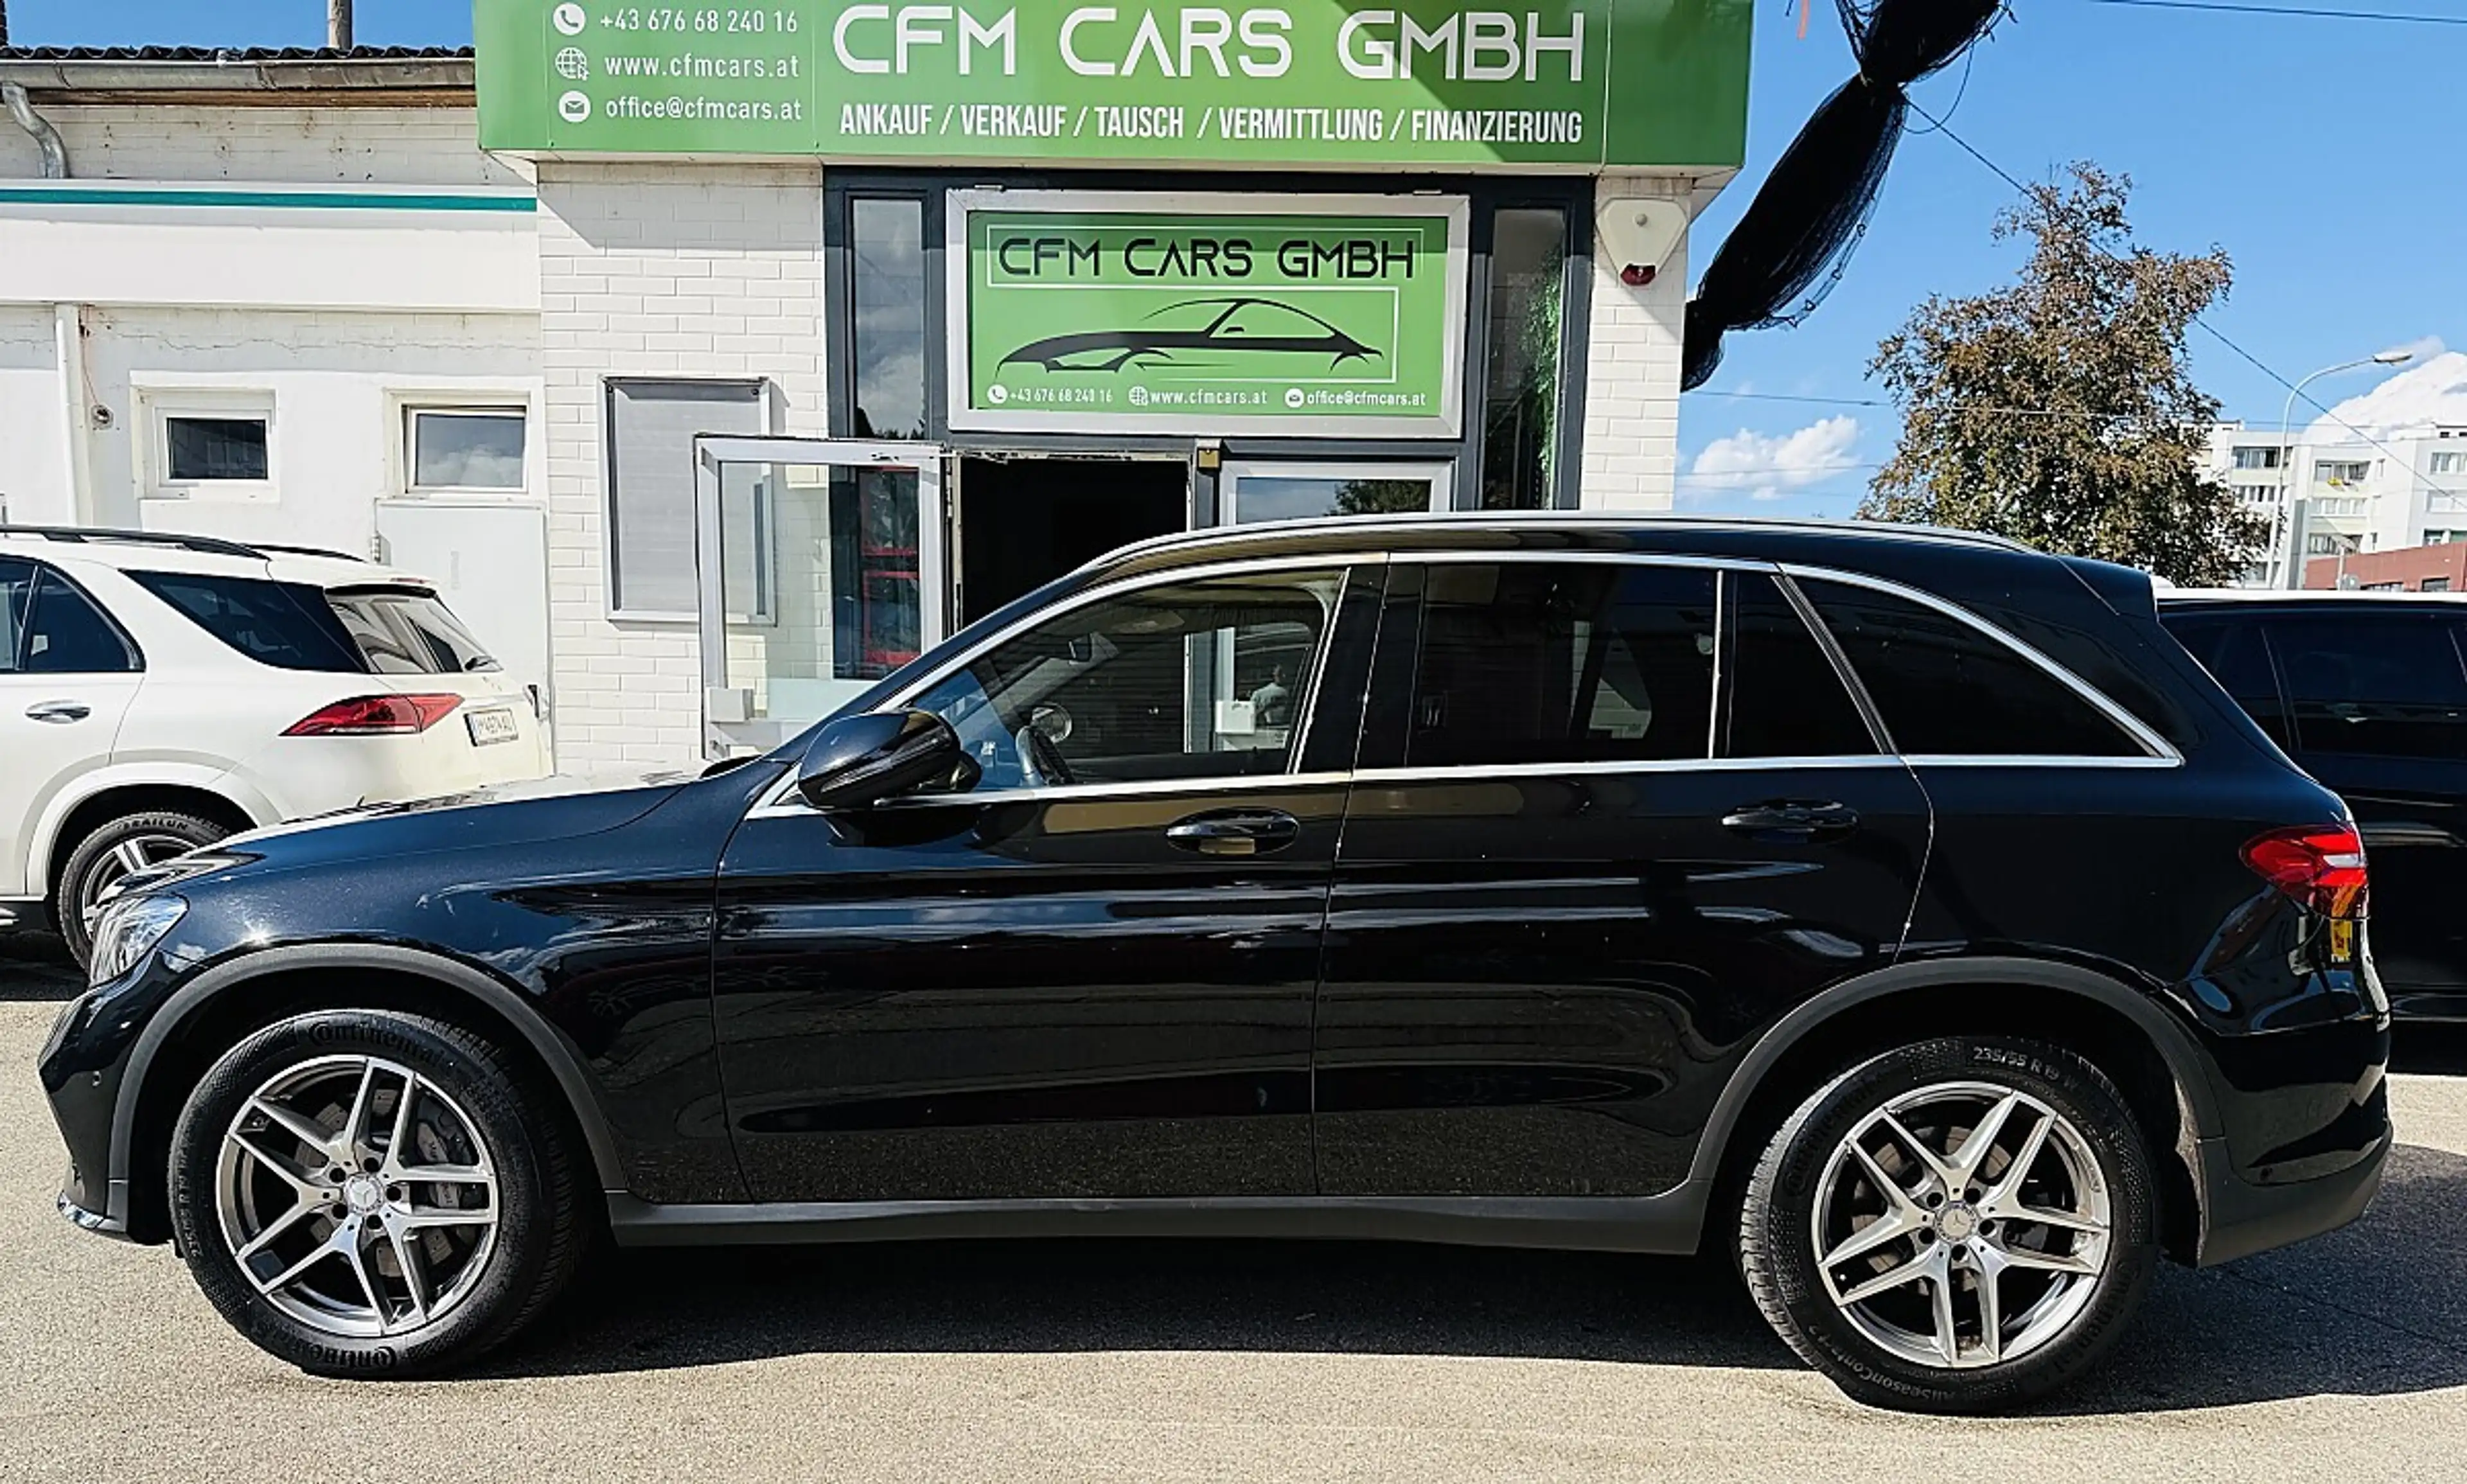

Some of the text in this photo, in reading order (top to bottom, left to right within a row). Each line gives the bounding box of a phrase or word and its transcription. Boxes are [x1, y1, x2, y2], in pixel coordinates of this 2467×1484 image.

[600, 9, 797, 32] +43 676 68 240 16
[833, 4, 1584, 81] CFM CARS GMBH
[605, 53, 799, 77] www.cfmcars.at
[606, 96, 802, 120] office@cfmcars.at
[840, 103, 933, 135] ANKAUF
[960, 105, 1067, 137] VERKAUF
[1095, 107, 1183, 138] TAUSCH
[1219, 108, 1383, 141] VERMITTLUNG
[1412, 110, 1582, 143] FINANZIERUNG
[999, 238, 1413, 278] CFM CARS GMBH
[1099, 388, 1113, 403] 16
[1150, 389, 1268, 404] www.cfmcars.at
[1307, 390, 1426, 406] office@cfmcars.at
